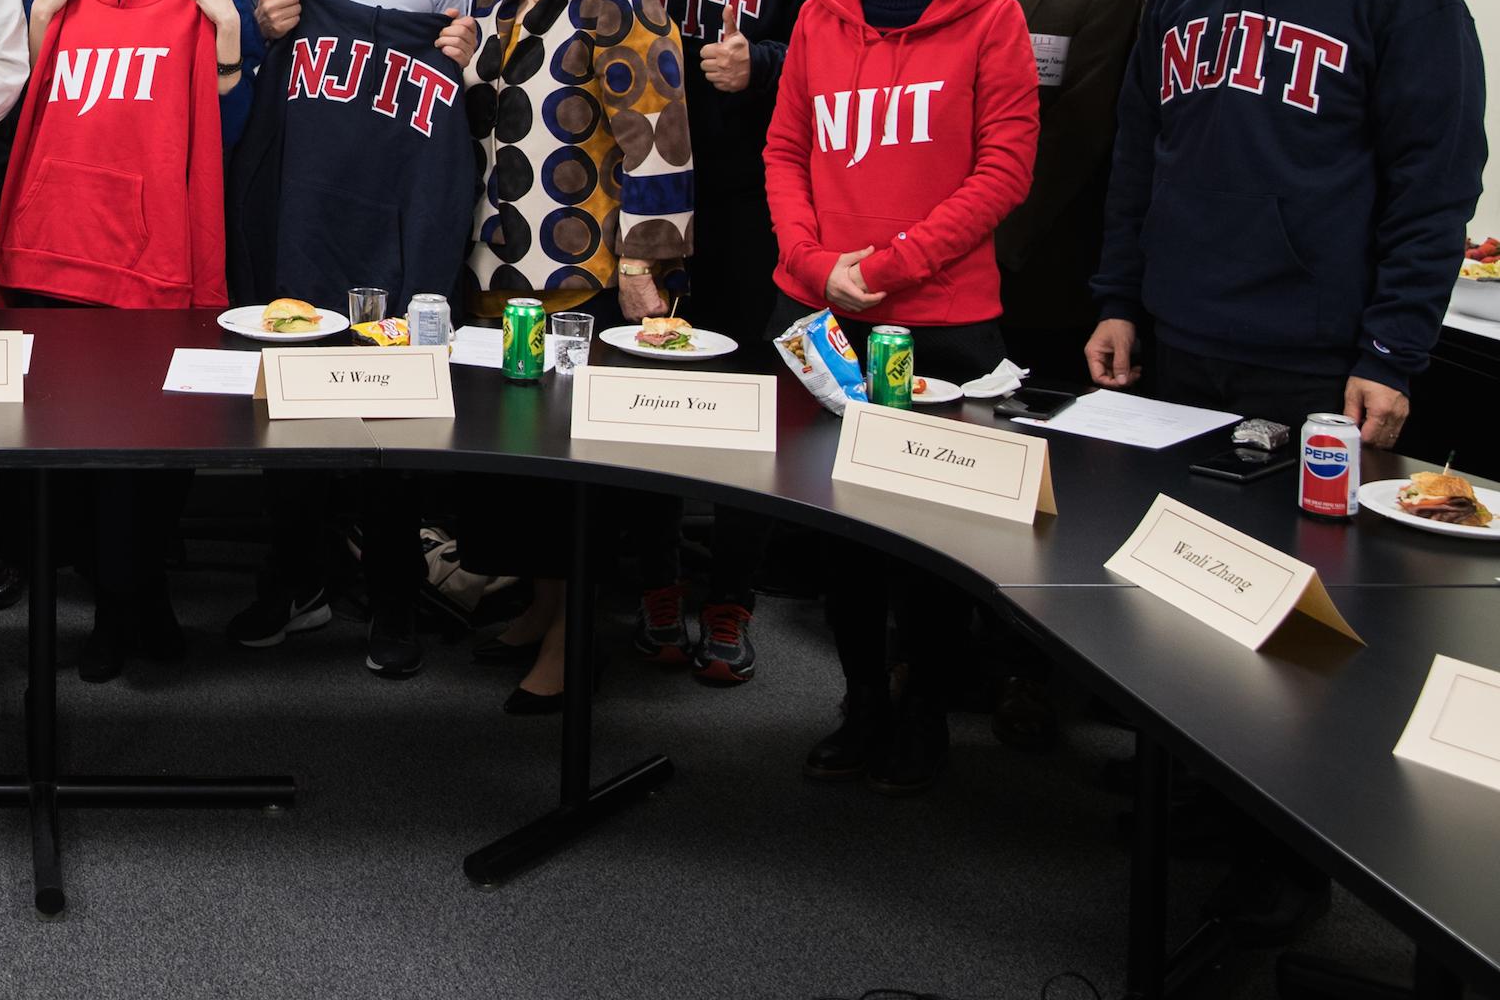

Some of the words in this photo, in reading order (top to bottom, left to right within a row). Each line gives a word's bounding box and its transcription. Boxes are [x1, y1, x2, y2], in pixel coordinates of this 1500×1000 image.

[49, 47, 169, 115] NJIT
[287, 36, 458, 138] NJIT
[1160, 11, 1348, 114] NJIT
[814, 80, 943, 168] NJIT
[328, 371, 345, 384] Xi
[349, 371, 391, 387] Wang
[629, 394, 681, 411] Jinjun
[687, 397, 717, 411] You
[901, 440, 930, 458] Xin
[933, 447, 977, 469] Zhan
[1305, 446, 1348, 463] PEPSI
[1172, 540, 1210, 569] Wanli
[1207, 560, 1254, 594] Zhang
